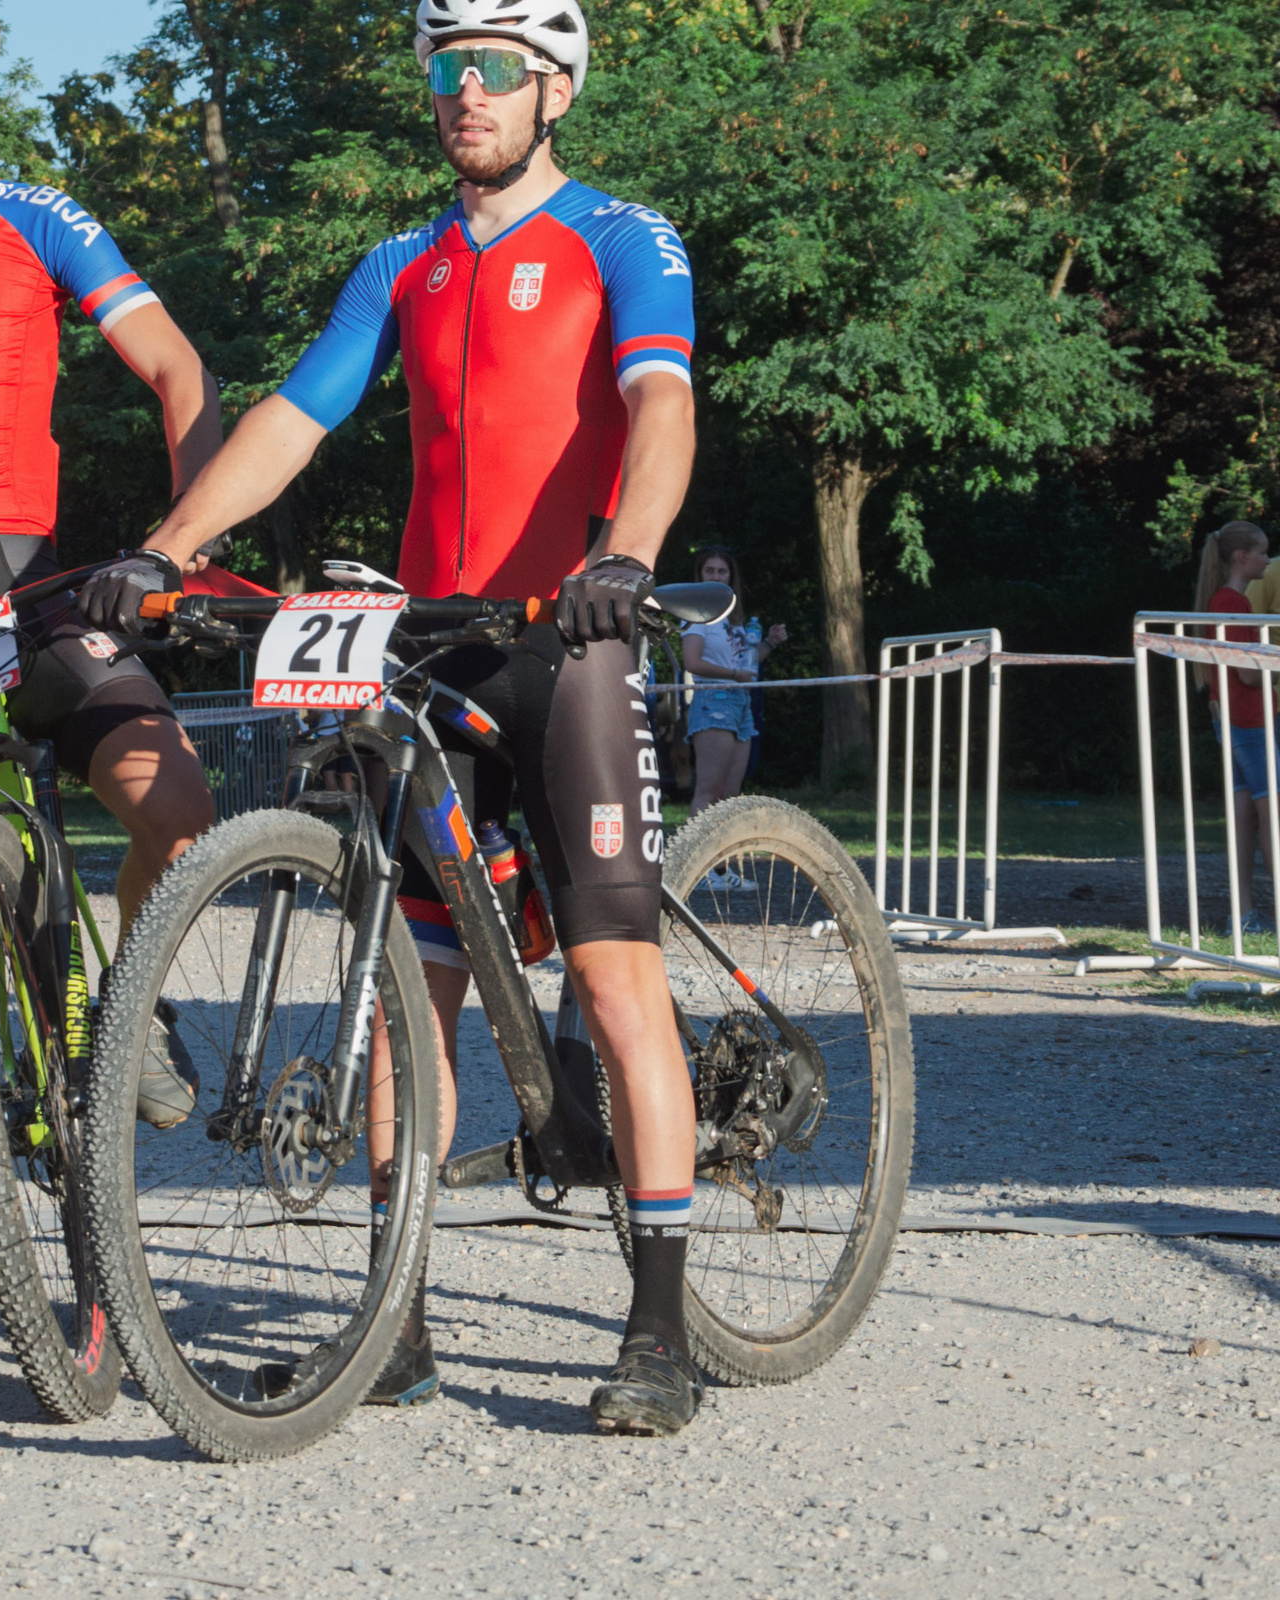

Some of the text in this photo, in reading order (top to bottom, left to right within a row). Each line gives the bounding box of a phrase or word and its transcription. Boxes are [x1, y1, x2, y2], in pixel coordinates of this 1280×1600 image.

[287, 593, 401, 608] SALCANO
[288, 613, 366, 674] 21
[261, 682, 377, 706] SALCANO
[389, 1152, 430, 1314] CONTINENTAL
